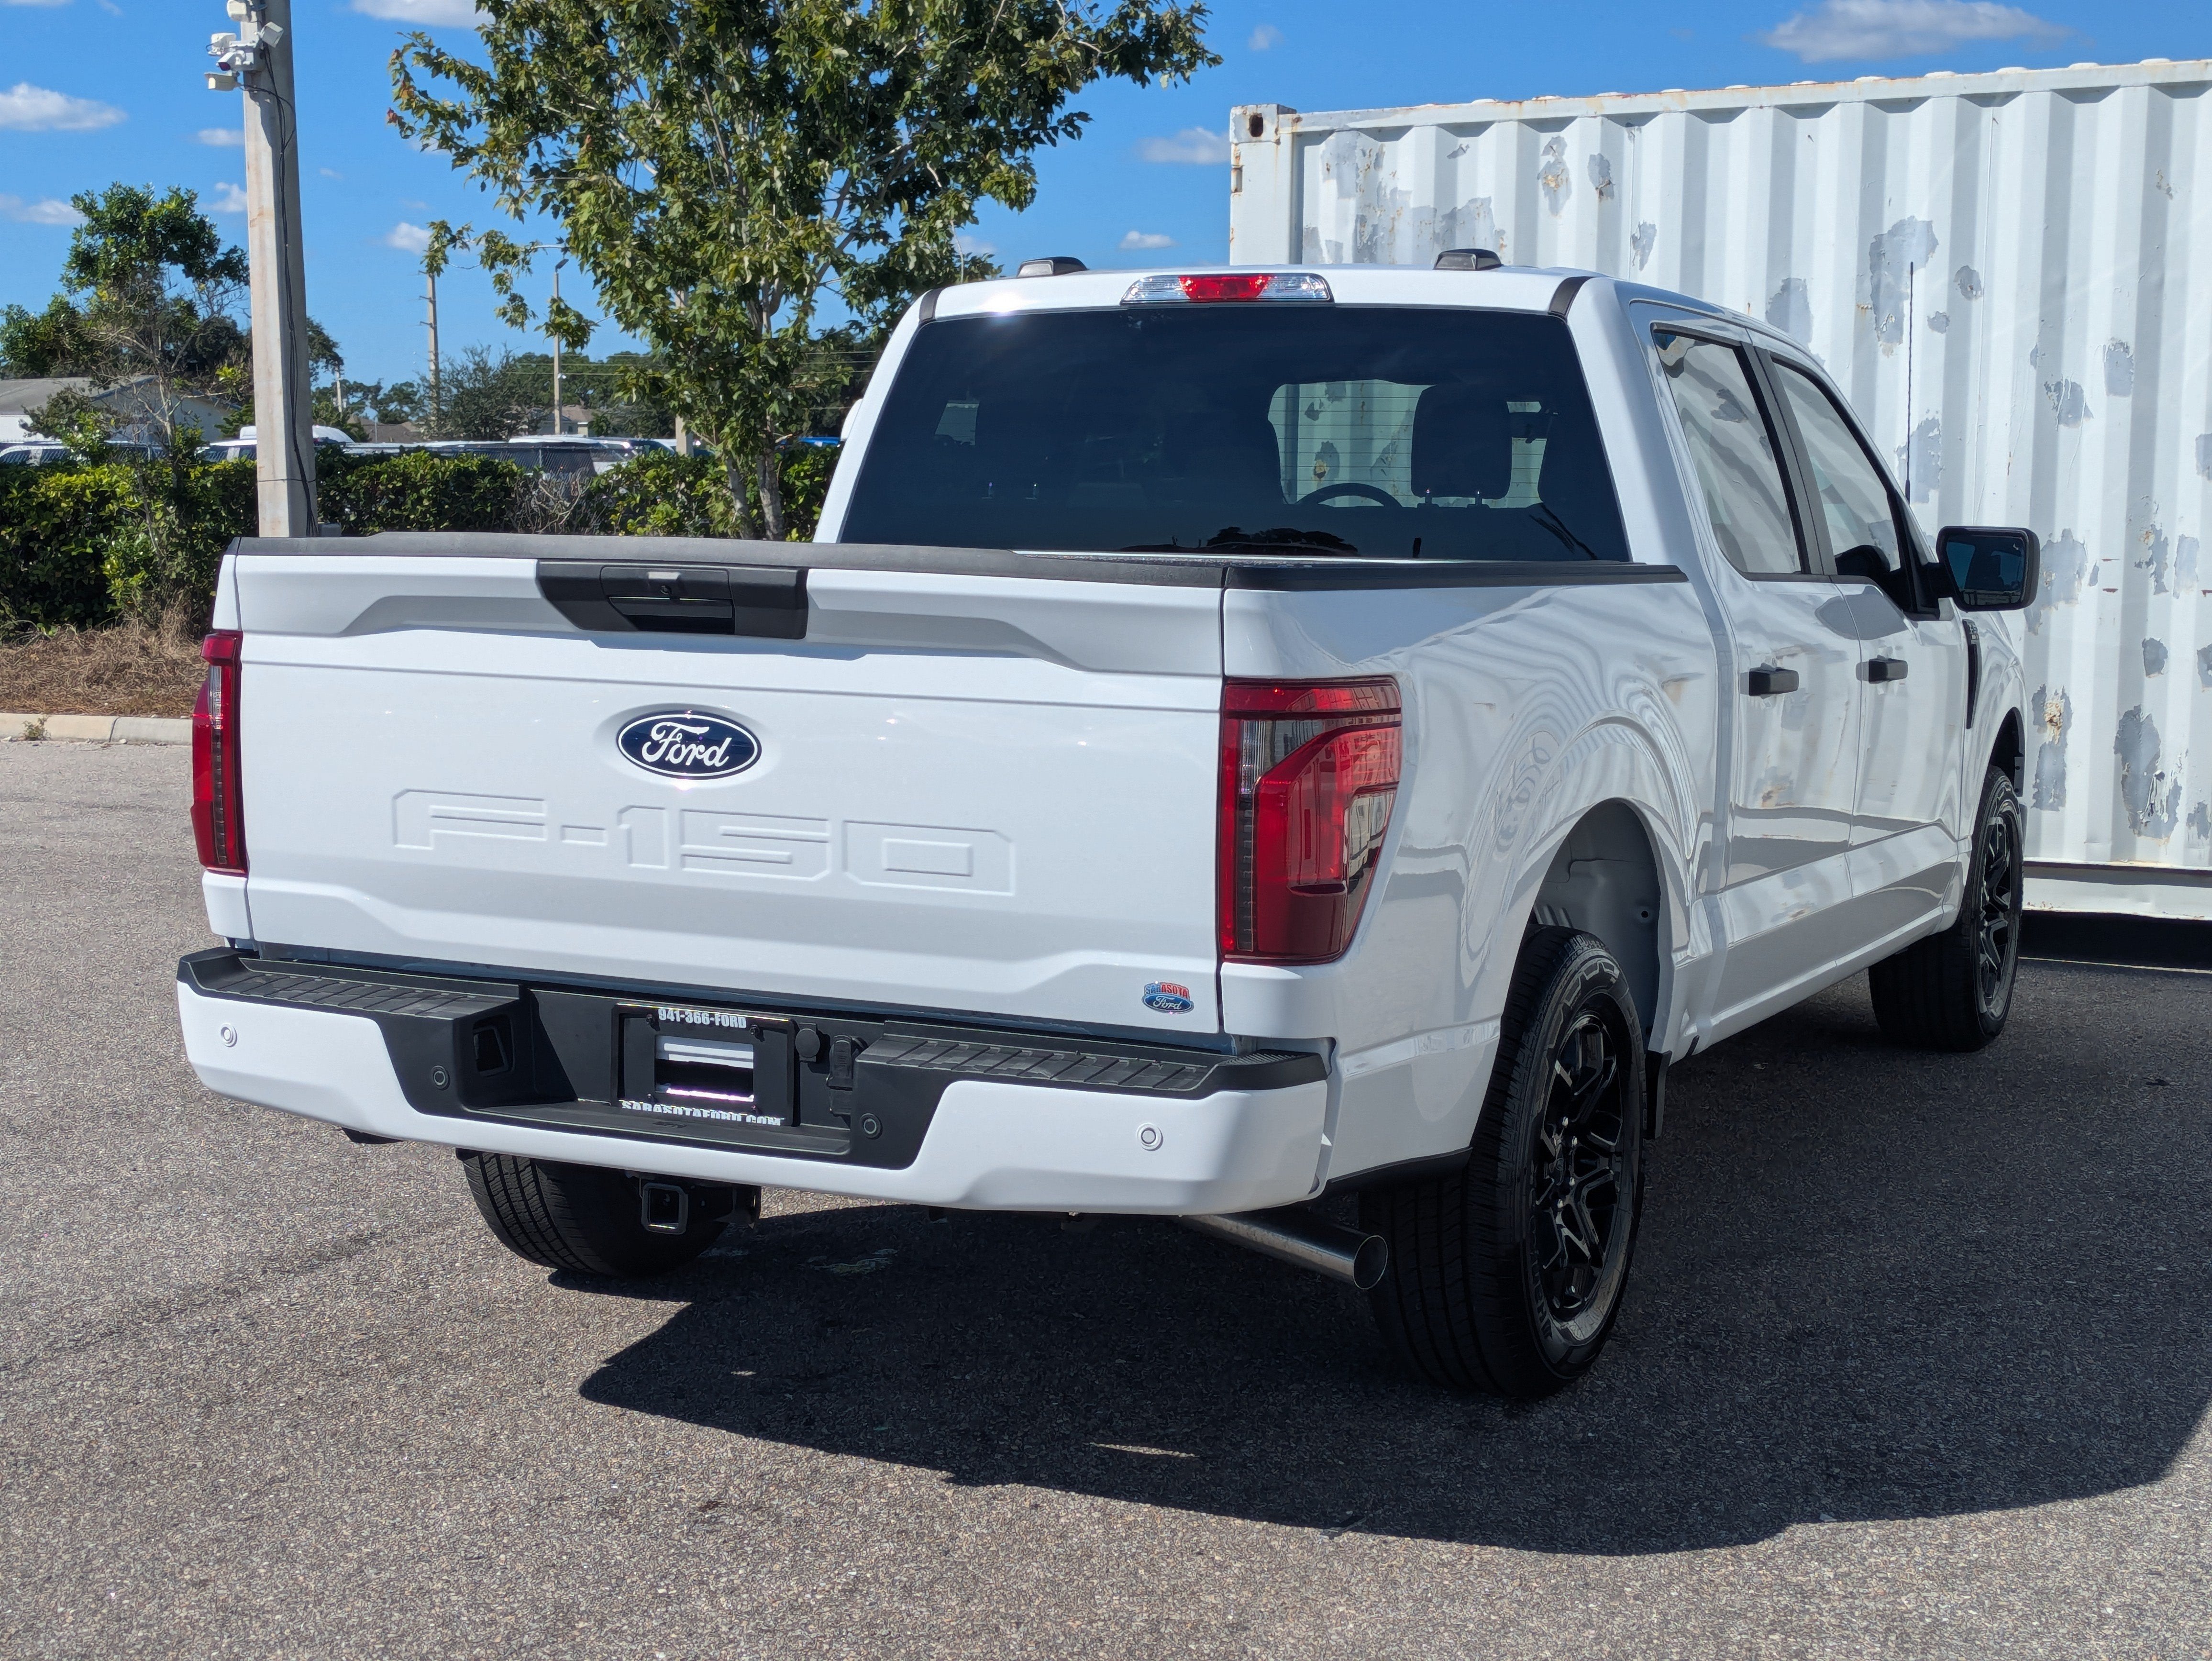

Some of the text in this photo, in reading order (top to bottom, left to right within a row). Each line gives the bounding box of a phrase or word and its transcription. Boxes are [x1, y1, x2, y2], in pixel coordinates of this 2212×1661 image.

[641, 721, 732, 767] Ford
[392, 789, 1015, 897] F-150
[1146, 984, 1188, 999] SARASOTA
[1153, 996, 1182, 1010] Ford
[658, 1008, 747, 1029] 941-366-FORD
[621, 1100, 781, 1126] SARASOTAFORDCOM
